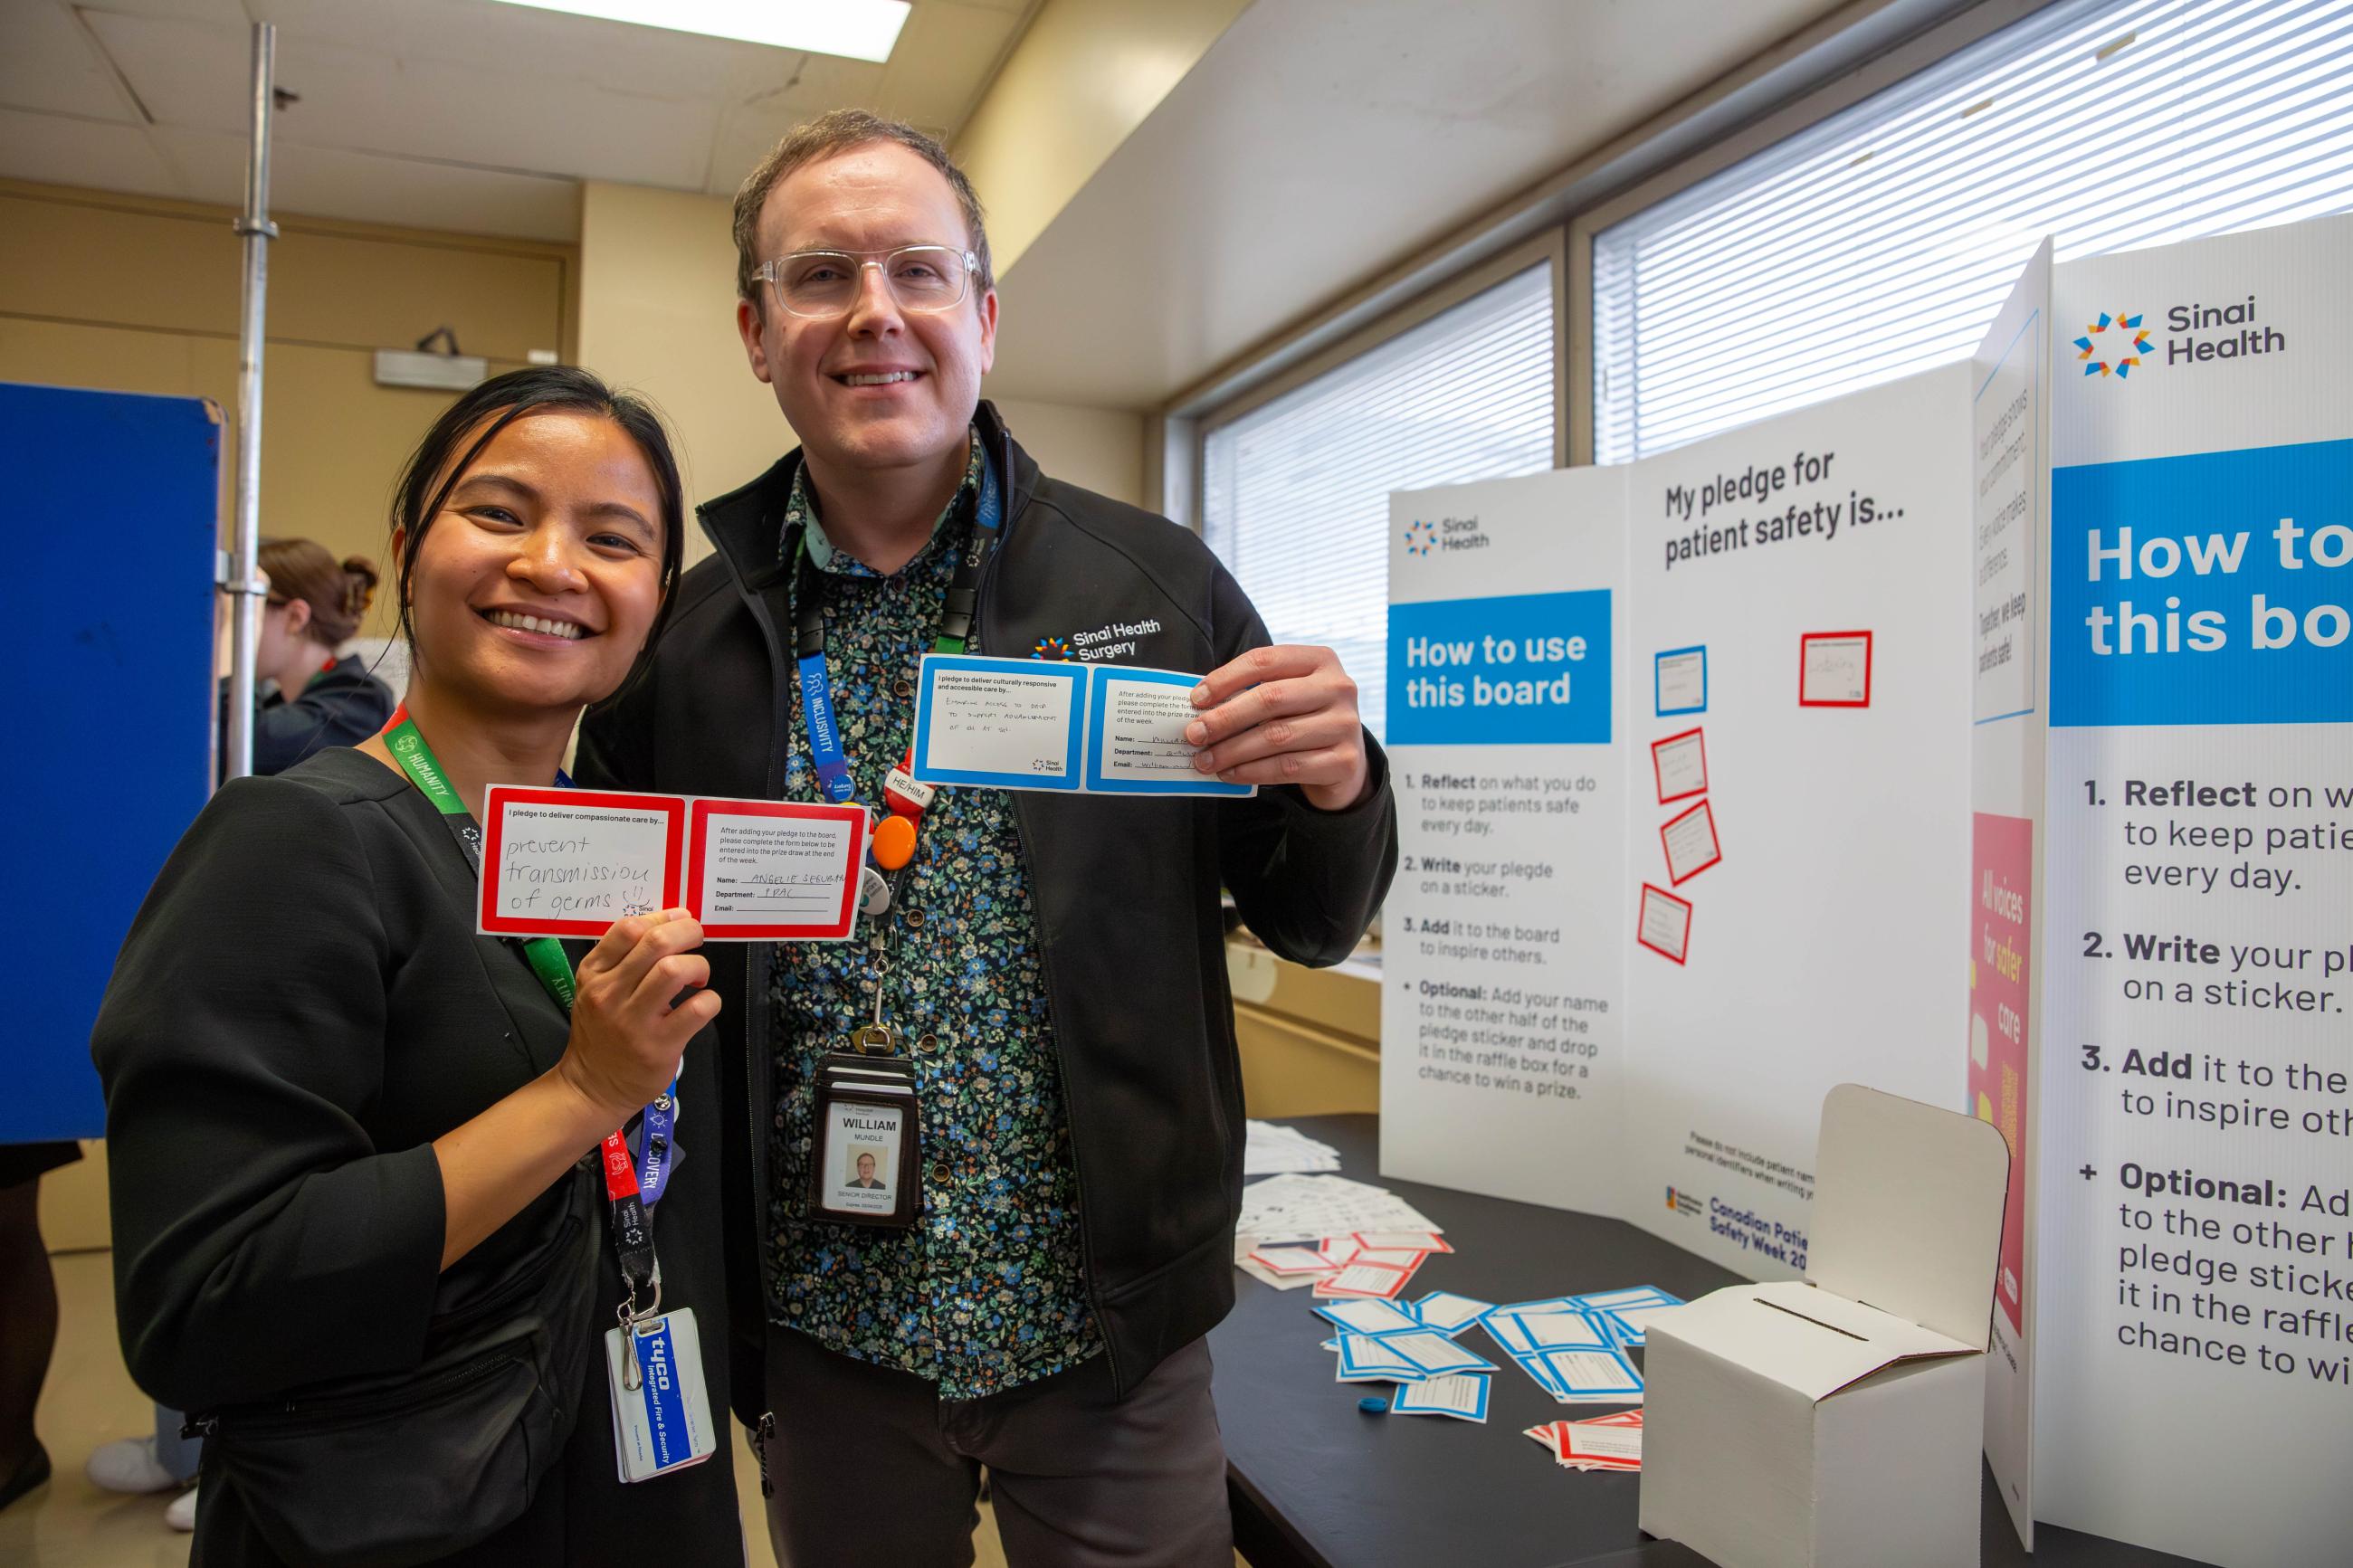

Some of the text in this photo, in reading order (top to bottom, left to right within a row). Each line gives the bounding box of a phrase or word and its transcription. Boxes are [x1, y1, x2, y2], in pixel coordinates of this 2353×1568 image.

[2167, 295, 2255, 332] Sinai
[2168, 327, 2284, 366] Health
[1667, 452, 1834, 521] My pledge for
[1442, 533, 1490, 551] Health
[1443, 516, 1479, 534] Sinai
[1667, 490, 1904, 570] patient safety is...
[2088, 518, 2353, 582] How to
[1073, 619, 1160, 646] Sinai Health
[2085, 596, 2226, 655] this
[1079, 641, 1135, 660] Surgery
[1407, 635, 1586, 668] How to use
[994, 679, 1022, 687] culturally
[1406, 671, 1570, 708] this board
[811, 697, 834, 753] INCLUSIVITY
[408, 753, 450, 796] HUMANITY
[893, 776, 925, 799] HE/HIM
[1405, 774, 1596, 794] 1. Reflect on what you do
[1421, 796, 1580, 813] to keep patients safe
[2084, 780, 2105, 805] 1.
[2125, 780, 2257, 807] Reflect
[2268, 787, 2311, 808] on
[512, 810, 538, 818] pledge
[548, 812, 573, 820] deliver
[575, 813, 631, 823] compassionate
[650, 816, 663, 824] by...
[739, 829, 760, 837] adding
[777, 831, 798, 839] pledge
[1421, 818, 1493, 836] every day.
[507, 836, 590, 860] prevent
[2124, 822, 2157, 845] to
[2170, 820, 2253, 854] keep
[506, 861, 650, 883] transmission
[1404, 857, 1553, 881] 2. Write your plegde
[2125, 861, 2301, 897] every day.
[511, 888, 611, 919] of germs
[1421, 879, 1510, 898] on a sticker.
[1983, 869, 2024, 925] All voices
[1404, 917, 1560, 944] 3. Add it to the board
[1420, 941, 1547, 965] to inspire others.
[1984, 922, 2023, 984] for safer
[2082, 932, 2112, 959] 2.
[2123, 933, 2220, 964] Write
[2230, 945, 2311, 973] your
[1419, 980, 1608, 1012] Optional: Add your name
[2124, 979, 2342, 1013] on a sticker.
[1997, 1002, 2021, 1044] care
[2082, 1044, 2347, 1094] 3. Add it to the
[843, 1117, 896, 1131] WILLIAM
[2121, 1089, 2154, 1116] to
[2167, 1091, 2290, 1130] inspire
[854, 1134, 883, 1142] MUNDLE
[643, 1133, 664, 1189] DCOVERY
[862, 1193, 892, 1201] DIRECTOR
[2120, 1163, 2287, 1209] Optional:
[629, 1202, 637, 1226] Health
[1710, 1196, 1770, 1235] Canadian
[2120, 1204, 2335, 1254] to the other
[1710, 1215, 1748, 1250] Safety
[1752, 1233, 1786, 1263] Week
[2120, 1243, 2237, 1286] pledge
[2120, 1279, 2140, 1307] it
[2152, 1285, 2180, 1314] in
[2193, 1293, 2251, 1326] the
[651, 1337, 670, 1390] tyco
[2118, 1322, 2246, 1365] chance
[2258, 1345, 2295, 1373] to
[648, 1365, 661, 1405] Integrated
[660, 1431, 670, 1464] Security
